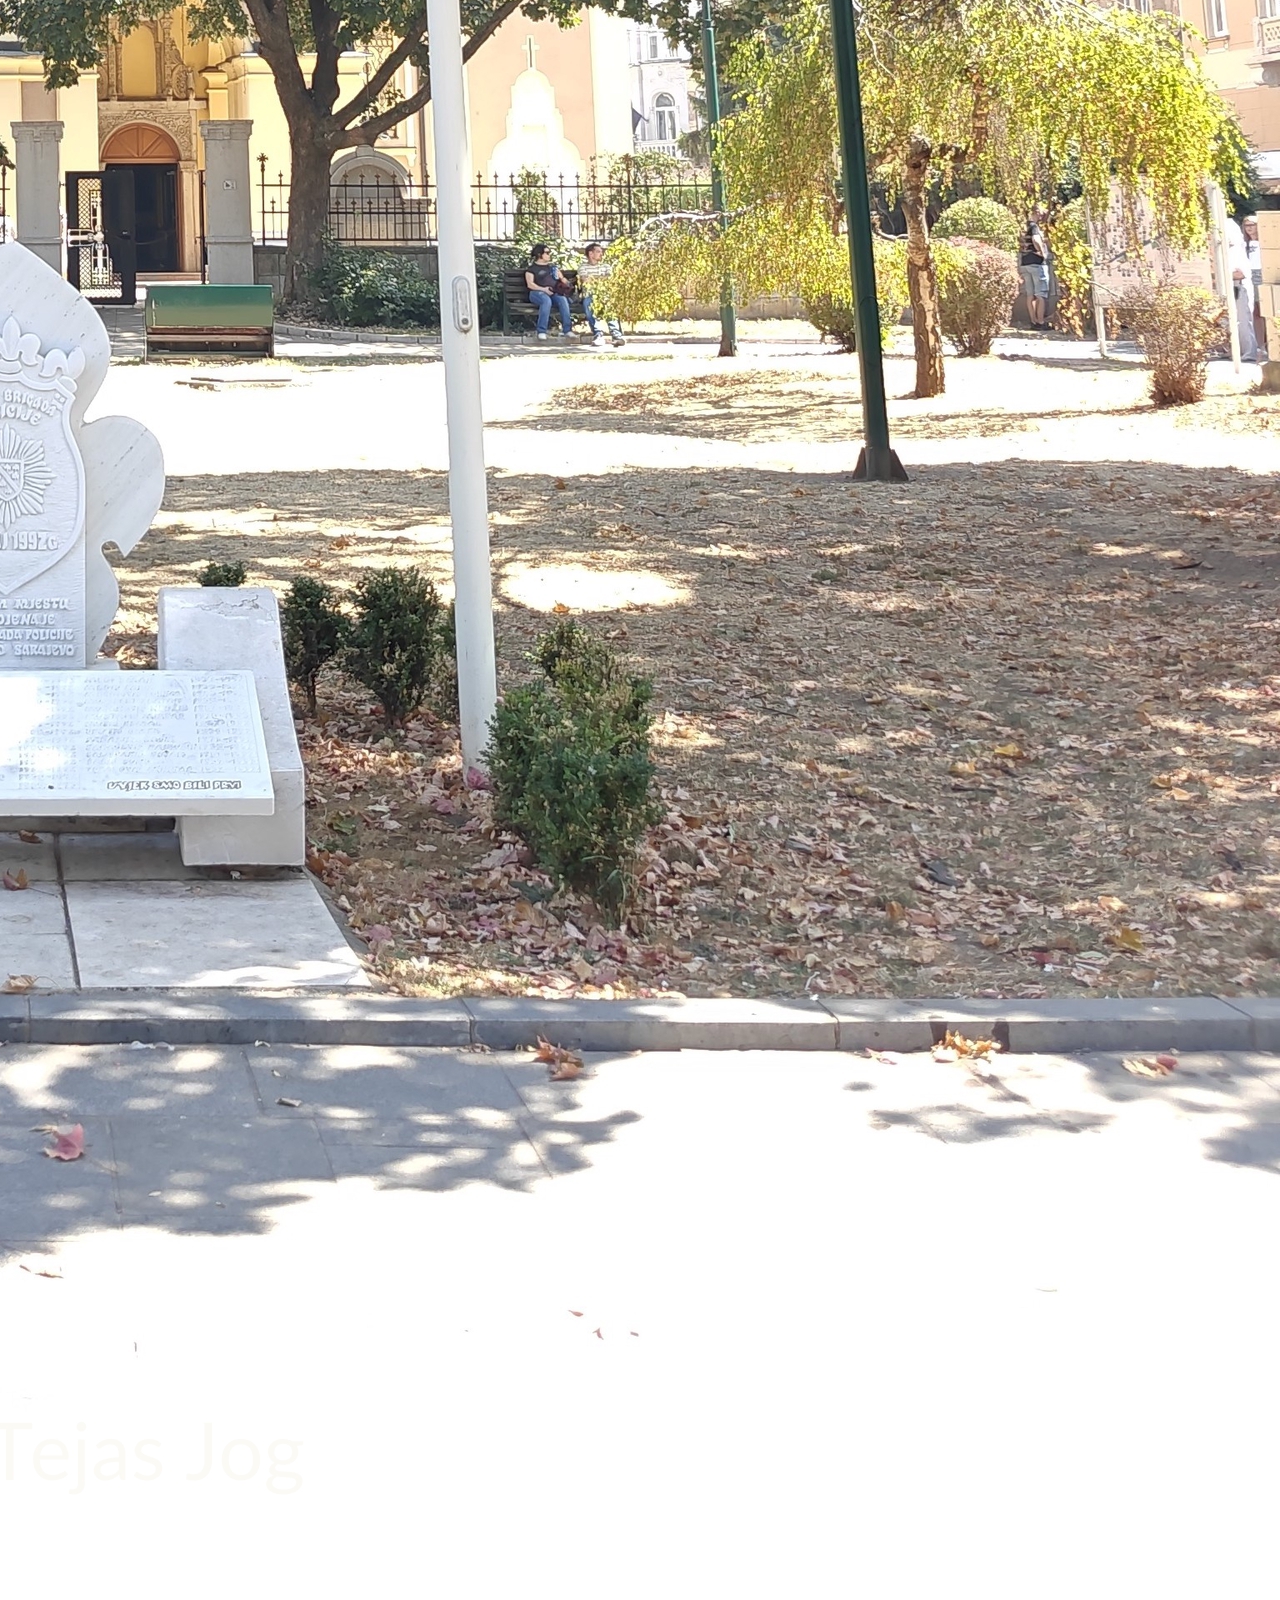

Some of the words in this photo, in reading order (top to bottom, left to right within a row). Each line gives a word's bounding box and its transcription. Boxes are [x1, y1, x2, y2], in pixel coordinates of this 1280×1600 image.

[3, 388, 57, 416] BRIGADA
[12, 597, 70, 610] MJESTU
[24, 629, 74, 641] POLICIJE
[13, 644, 75, 657] SARAJEVO
[107, 780, 150, 791] UVJEK
[152, 780, 181, 790] SMO
[183, 780, 211, 789] BILI
[213, 780, 241, 789] PRVI
